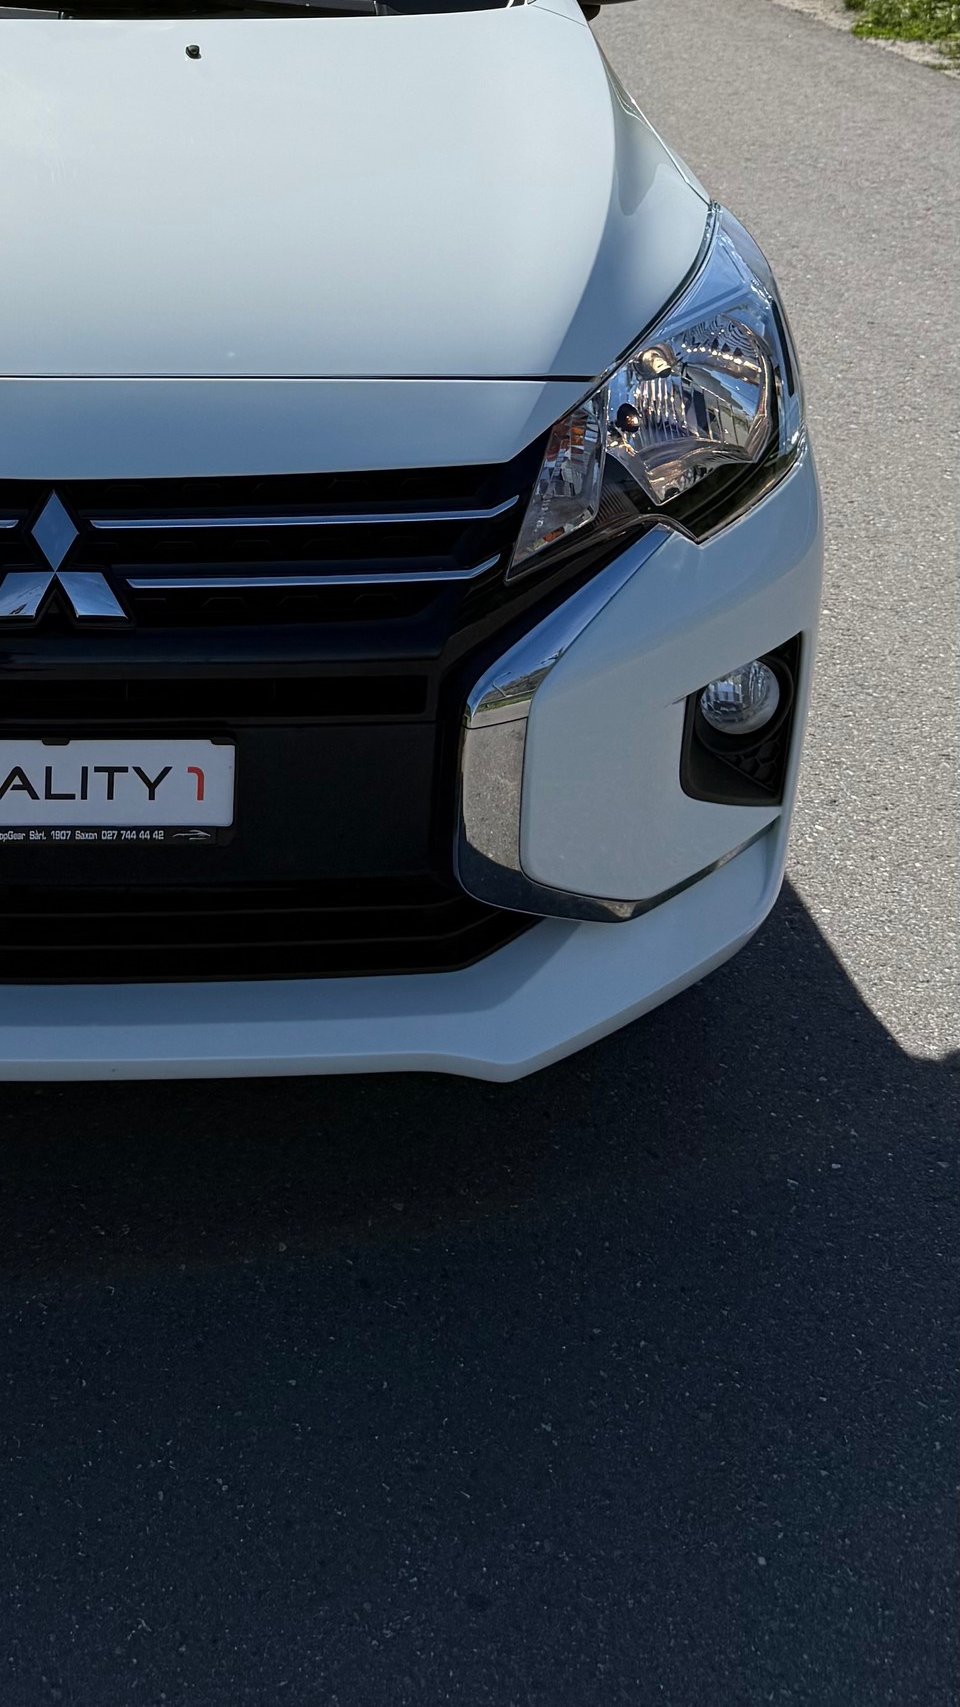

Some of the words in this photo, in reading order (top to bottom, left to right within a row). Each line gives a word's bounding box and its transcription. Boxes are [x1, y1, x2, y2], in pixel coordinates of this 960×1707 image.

[50, 830, 72, 840] 1907
[75, 830, 98, 840] Saxon
[101, 830, 118, 840] 027
[120, 830, 137, 840] 744
[139, 830, 151, 840] 44
[152, 830, 165, 840] 42
